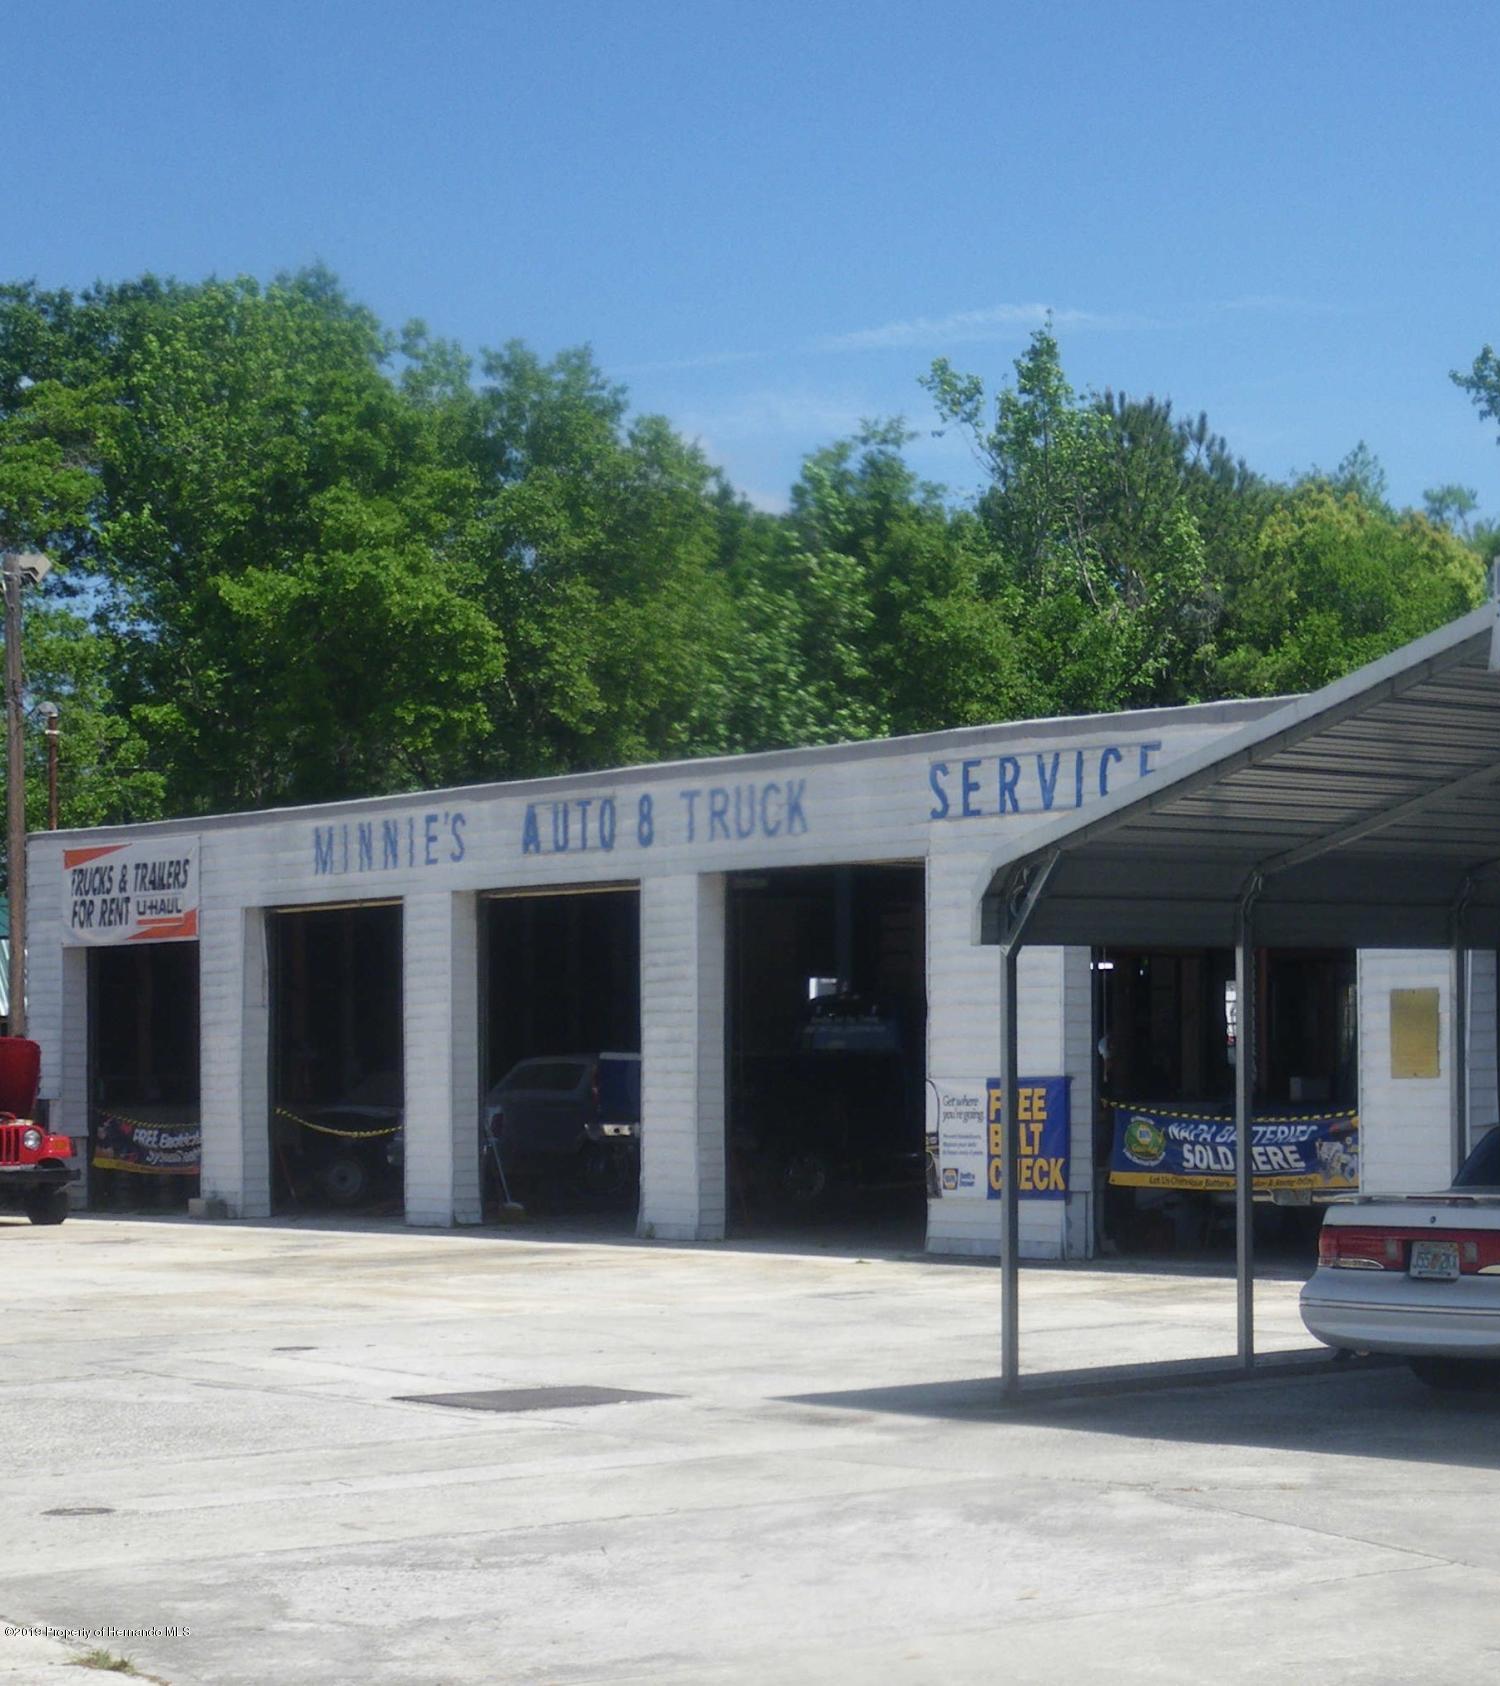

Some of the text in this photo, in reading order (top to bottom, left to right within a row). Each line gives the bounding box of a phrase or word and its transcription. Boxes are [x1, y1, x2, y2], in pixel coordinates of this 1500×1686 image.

[313, 811, 466, 875] MINNIE'S
[522, 794, 617, 855] AUTO
[680, 778, 809, 843] TRUCK
[71, 858, 190, 897] TRUCKS & TRAILERS
[72, 896, 182, 929] FOR RENT U-HAUL
[989, 1088, 1047, 1120] FEE
[989, 1123, 1043, 1155] BLT
[1215, 1124, 1318, 1144] BATERIES
[1182, 1144, 1236, 1170] SOLD
[1250, 1145, 1306, 1171] ERE
[989, 1157, 1066, 1191] CECK
